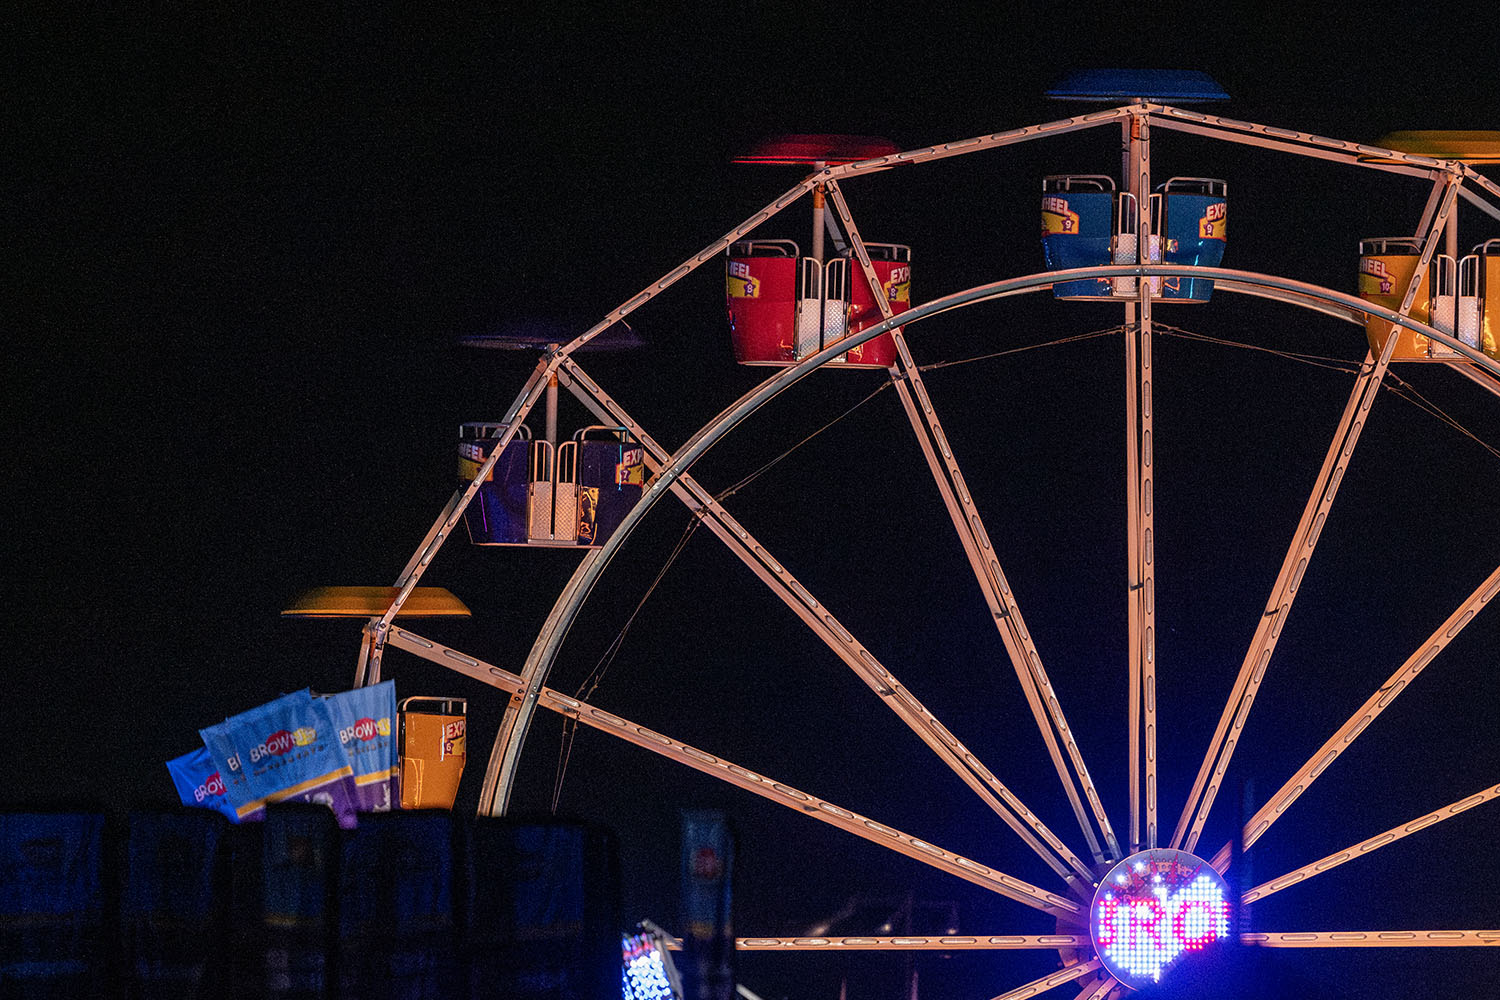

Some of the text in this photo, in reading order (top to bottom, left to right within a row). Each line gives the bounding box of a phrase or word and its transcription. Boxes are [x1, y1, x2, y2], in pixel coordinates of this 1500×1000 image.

[1065, 220, 1072, 229] 9
[1206, 224, 1213, 234] 9
[746, 284, 754, 294] 8
[1381, 282, 1391, 291] 10
[890, 287, 896, 297] 8
[622, 470, 629, 480] 7
[446, 742, 452, 752] 6
